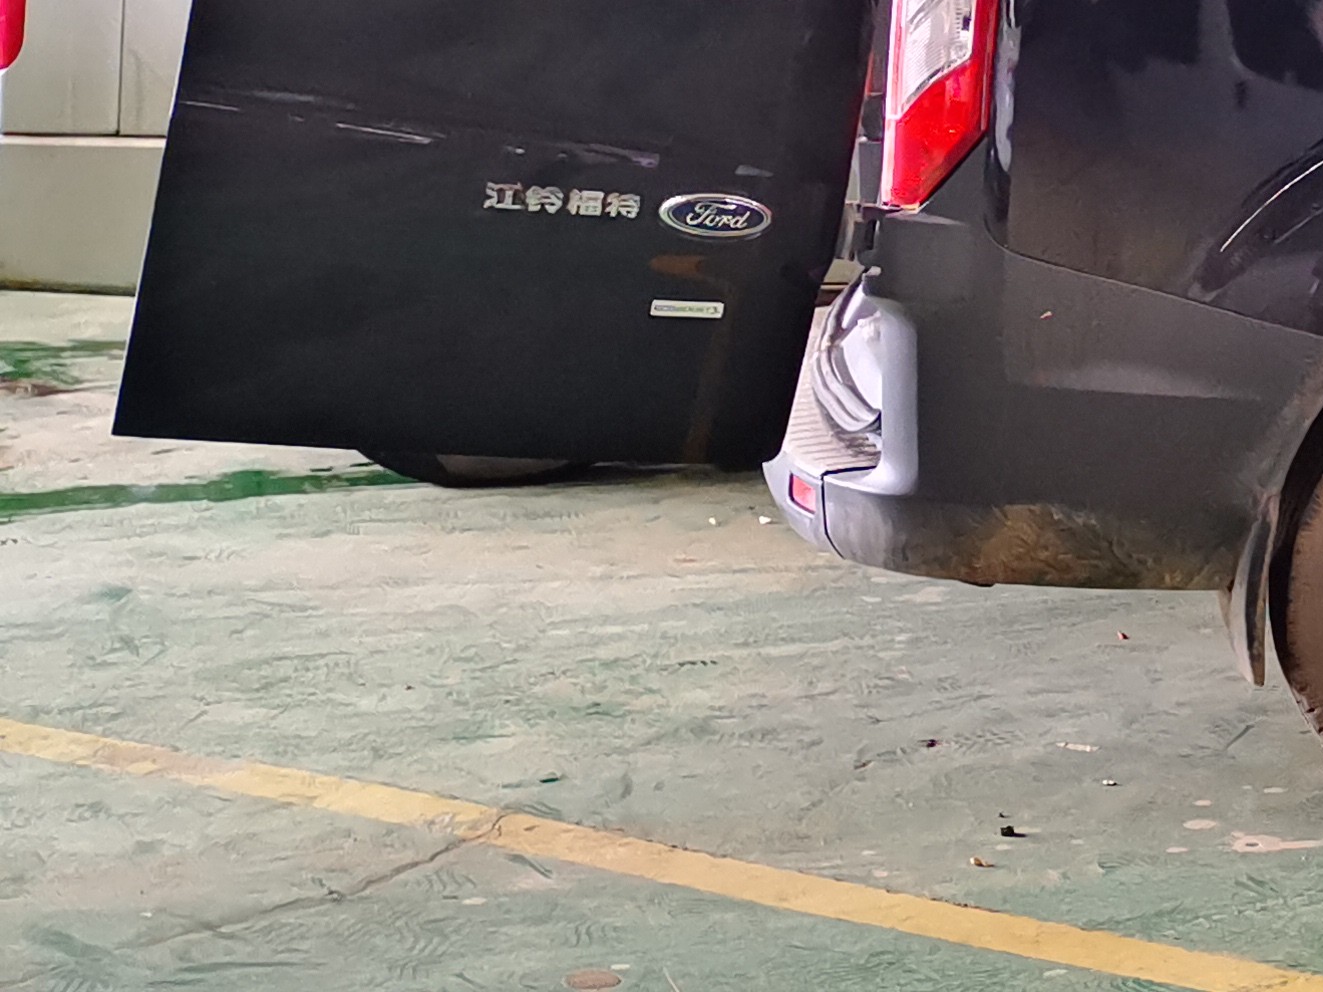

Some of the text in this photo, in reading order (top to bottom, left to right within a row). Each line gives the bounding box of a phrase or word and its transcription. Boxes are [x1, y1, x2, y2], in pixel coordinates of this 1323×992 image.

[483, 182, 641, 219] 江铃福特
[686, 201, 749, 230] Ford
